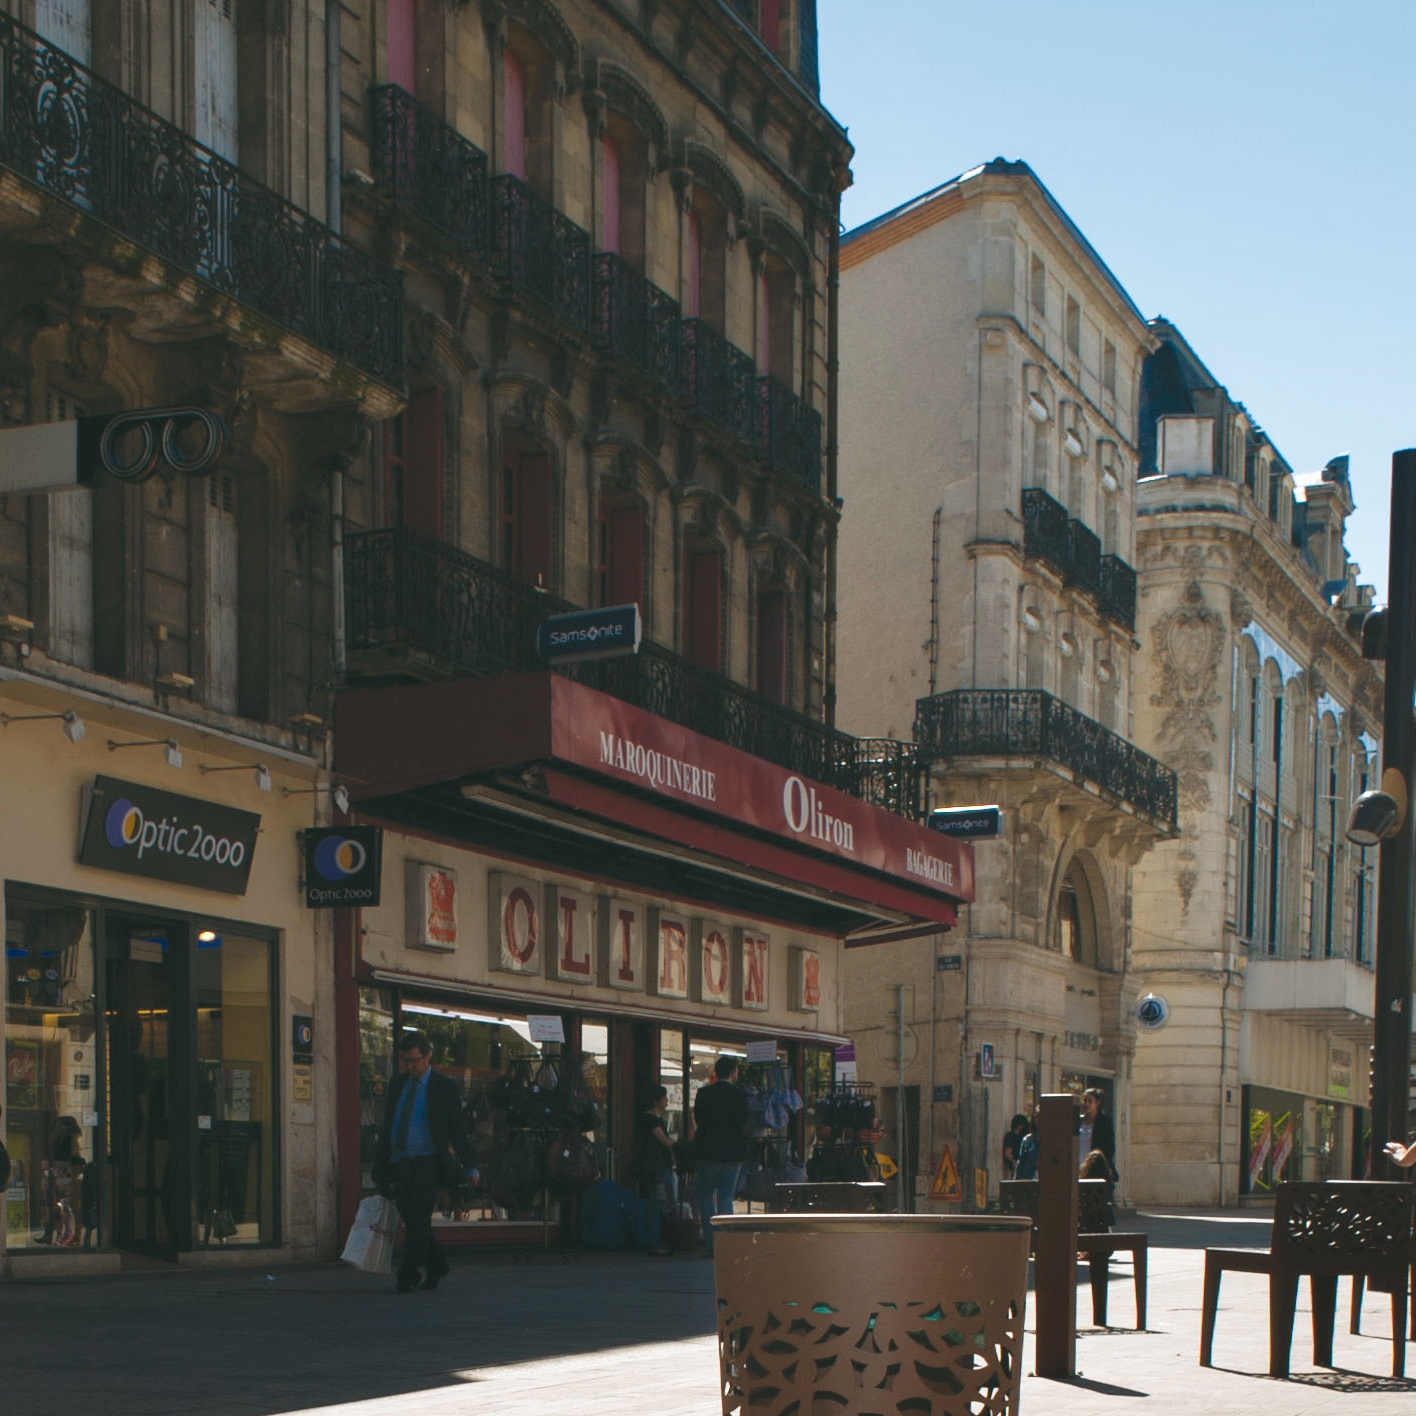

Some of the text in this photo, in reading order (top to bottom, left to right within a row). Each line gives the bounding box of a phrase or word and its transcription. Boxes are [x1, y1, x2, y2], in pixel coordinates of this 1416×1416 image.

[549, 621, 624, 646] Samsonite
[599, 730, 717, 803] MAROQUINERIE
[121, 806, 245, 868] Optic 2000
[782, 776, 855, 852] Oliron
[308, 887, 373, 902] Optic 2000
[905, 846, 955, 888] BAGAGERIE
[504, 886, 768, 1004] OLIRON
